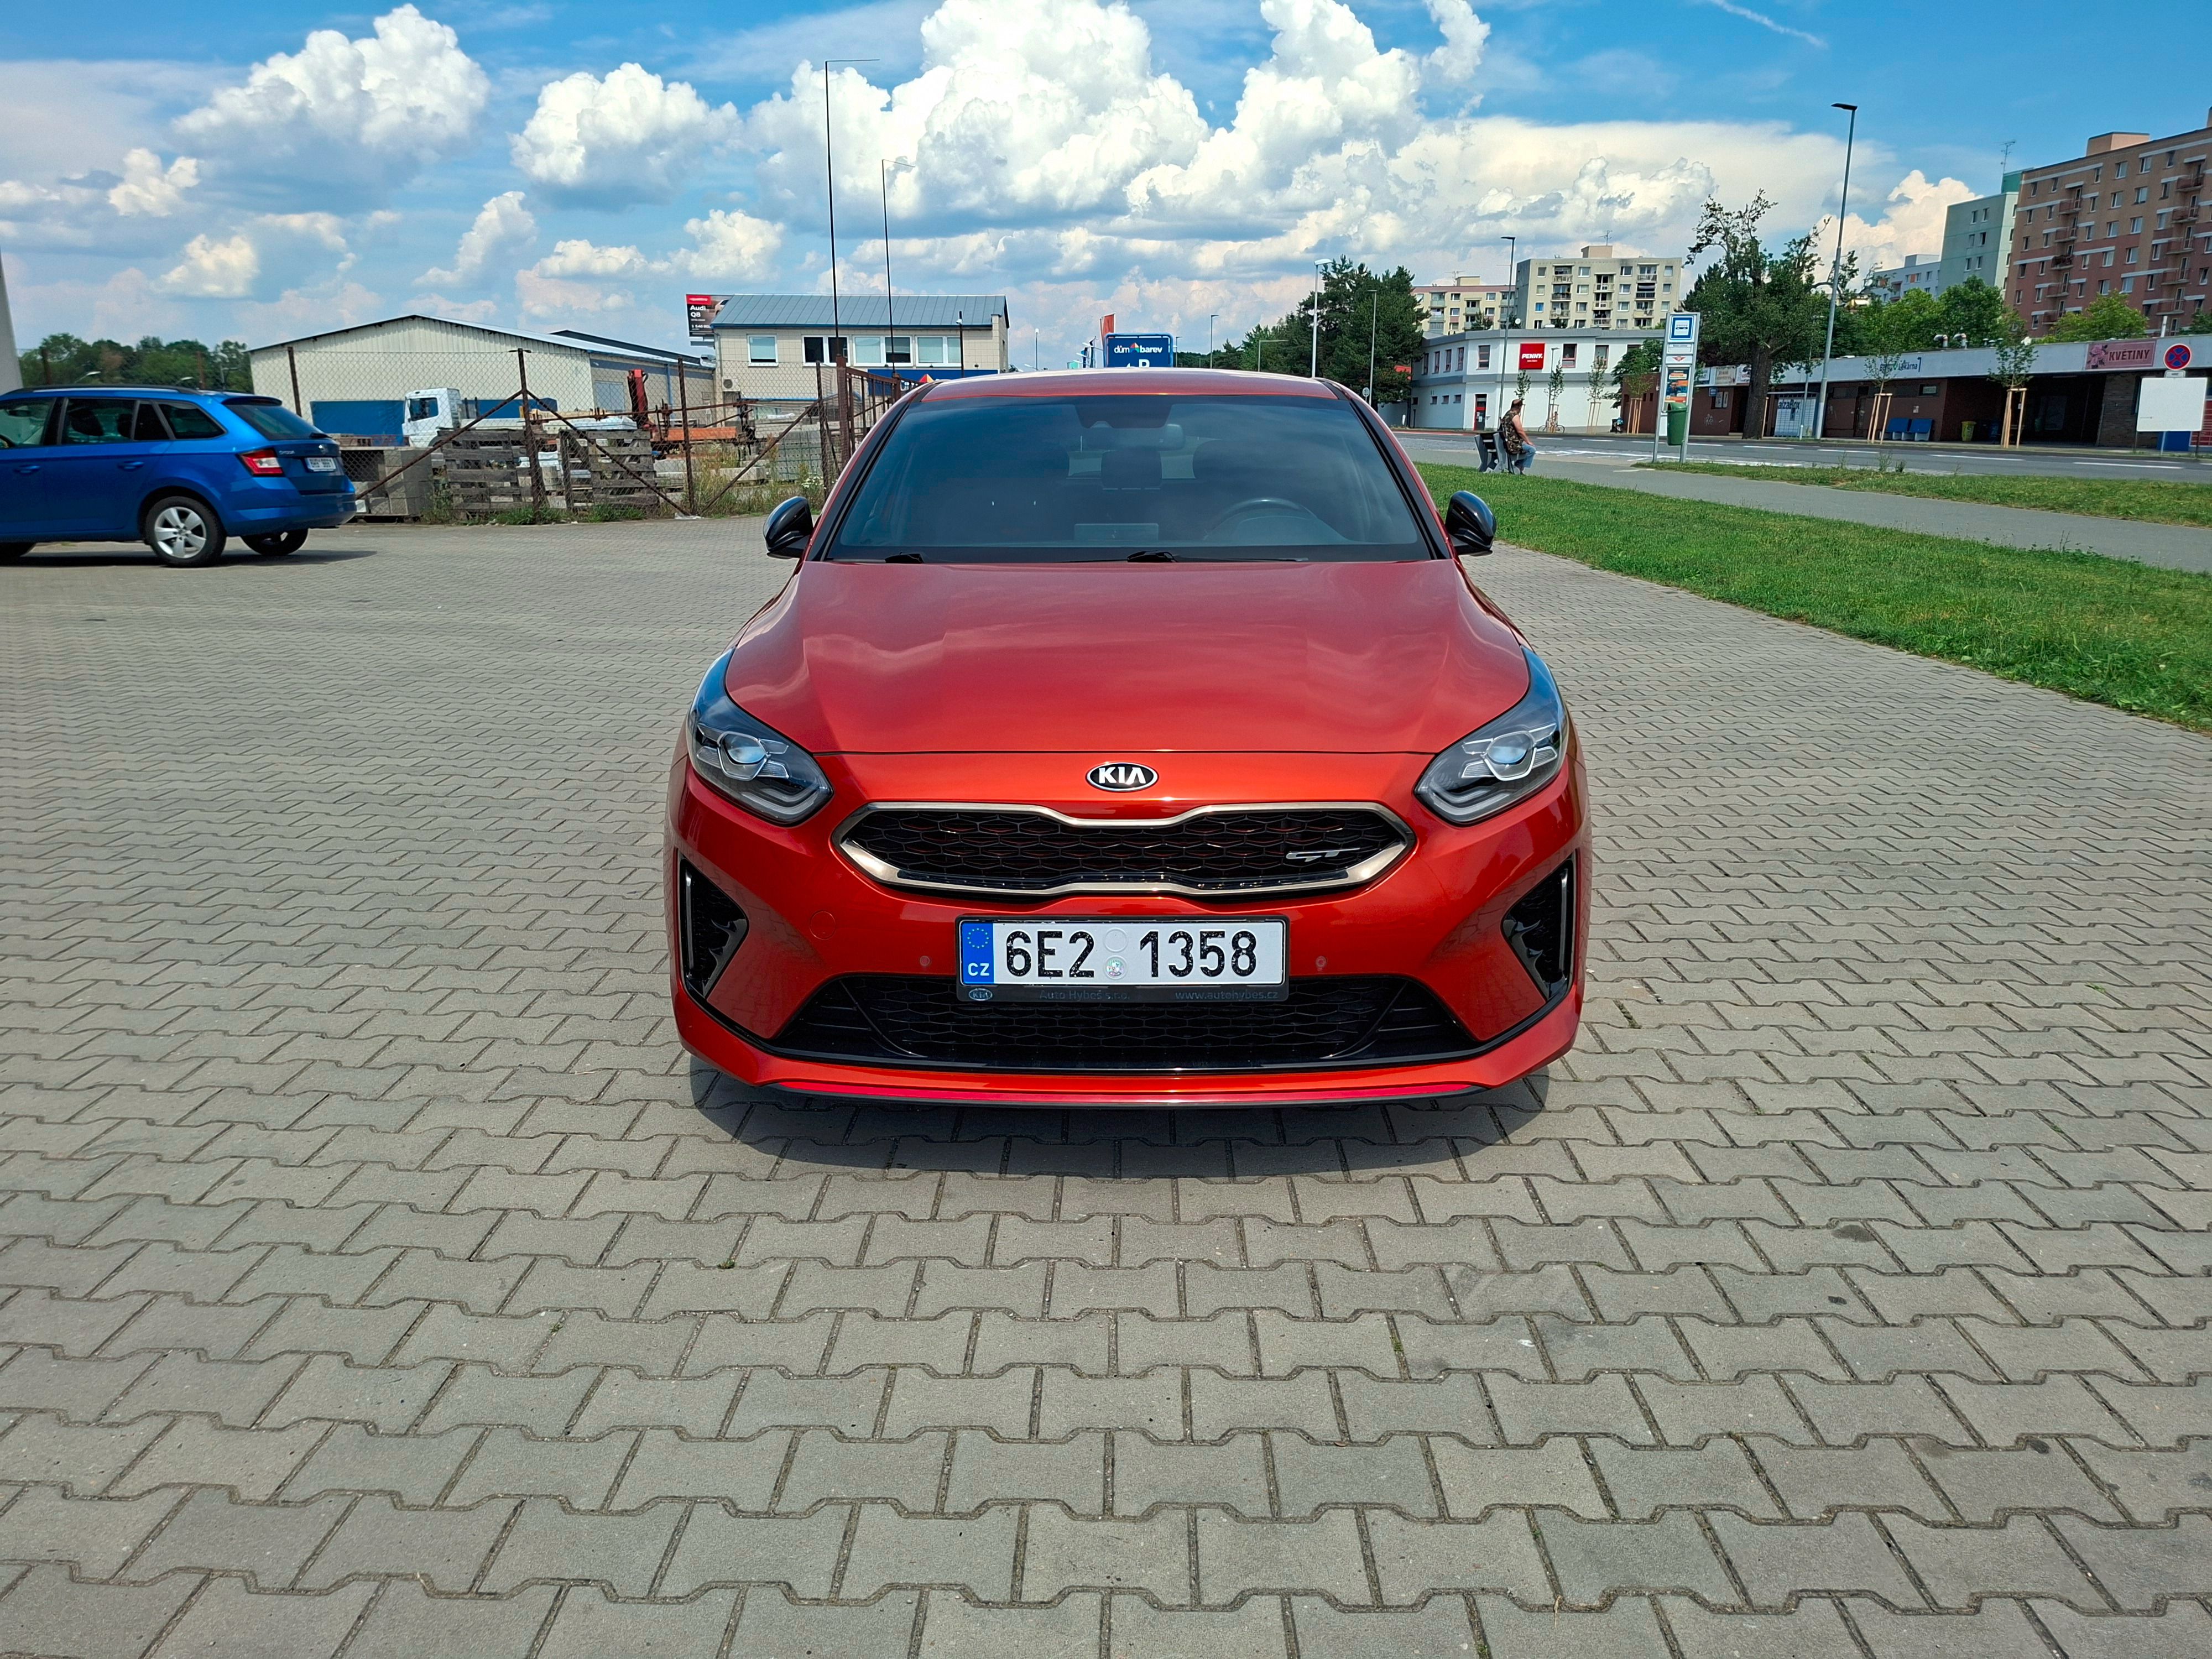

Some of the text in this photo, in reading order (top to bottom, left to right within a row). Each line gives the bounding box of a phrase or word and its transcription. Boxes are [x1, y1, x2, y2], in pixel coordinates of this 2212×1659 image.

[2109, 349, 2151, 361] KVĚTINY
[1098, 766, 1146, 785] KIA
[1286, 848, 1360, 862] GT
[1005, 930, 1258, 978] 6E2 1358
[968, 962, 990, 977] CZ
[1039, 990, 1065, 999] Auto
[1175, 988, 1279, 1001] www.autohybes.cz
